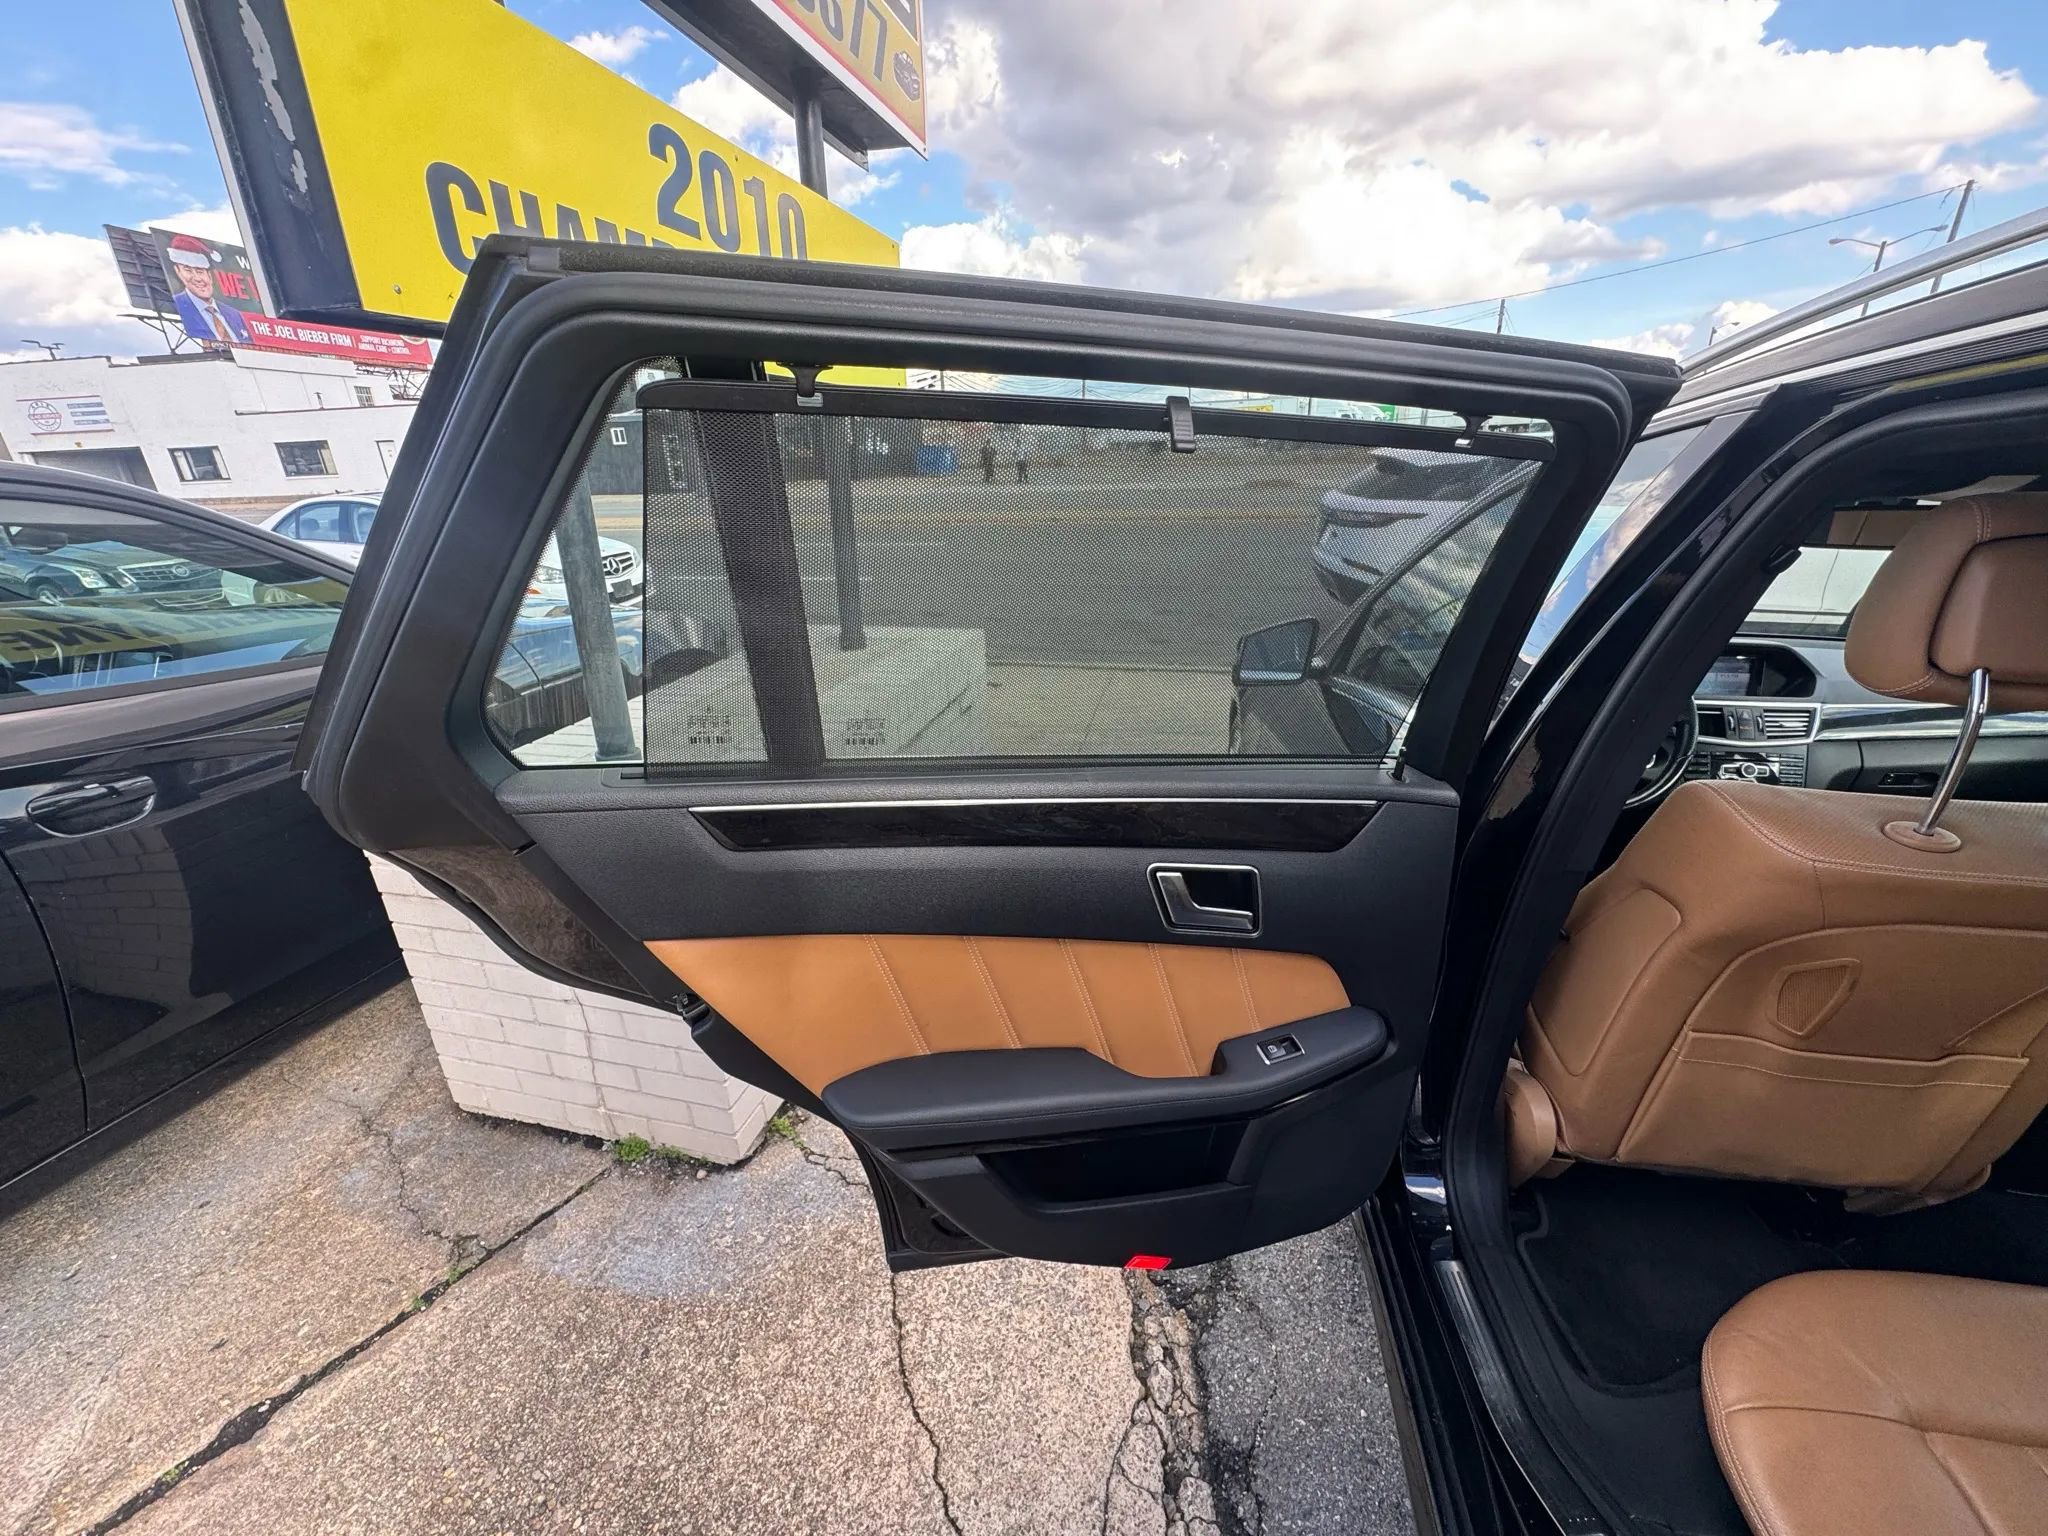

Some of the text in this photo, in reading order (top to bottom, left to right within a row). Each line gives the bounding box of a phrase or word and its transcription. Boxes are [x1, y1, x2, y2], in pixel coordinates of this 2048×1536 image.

[648, 123, 808, 260] 2010
[214, 270, 249, 300] WE
[250, 320, 352, 347] THE JOEL BIEBER FIRM
